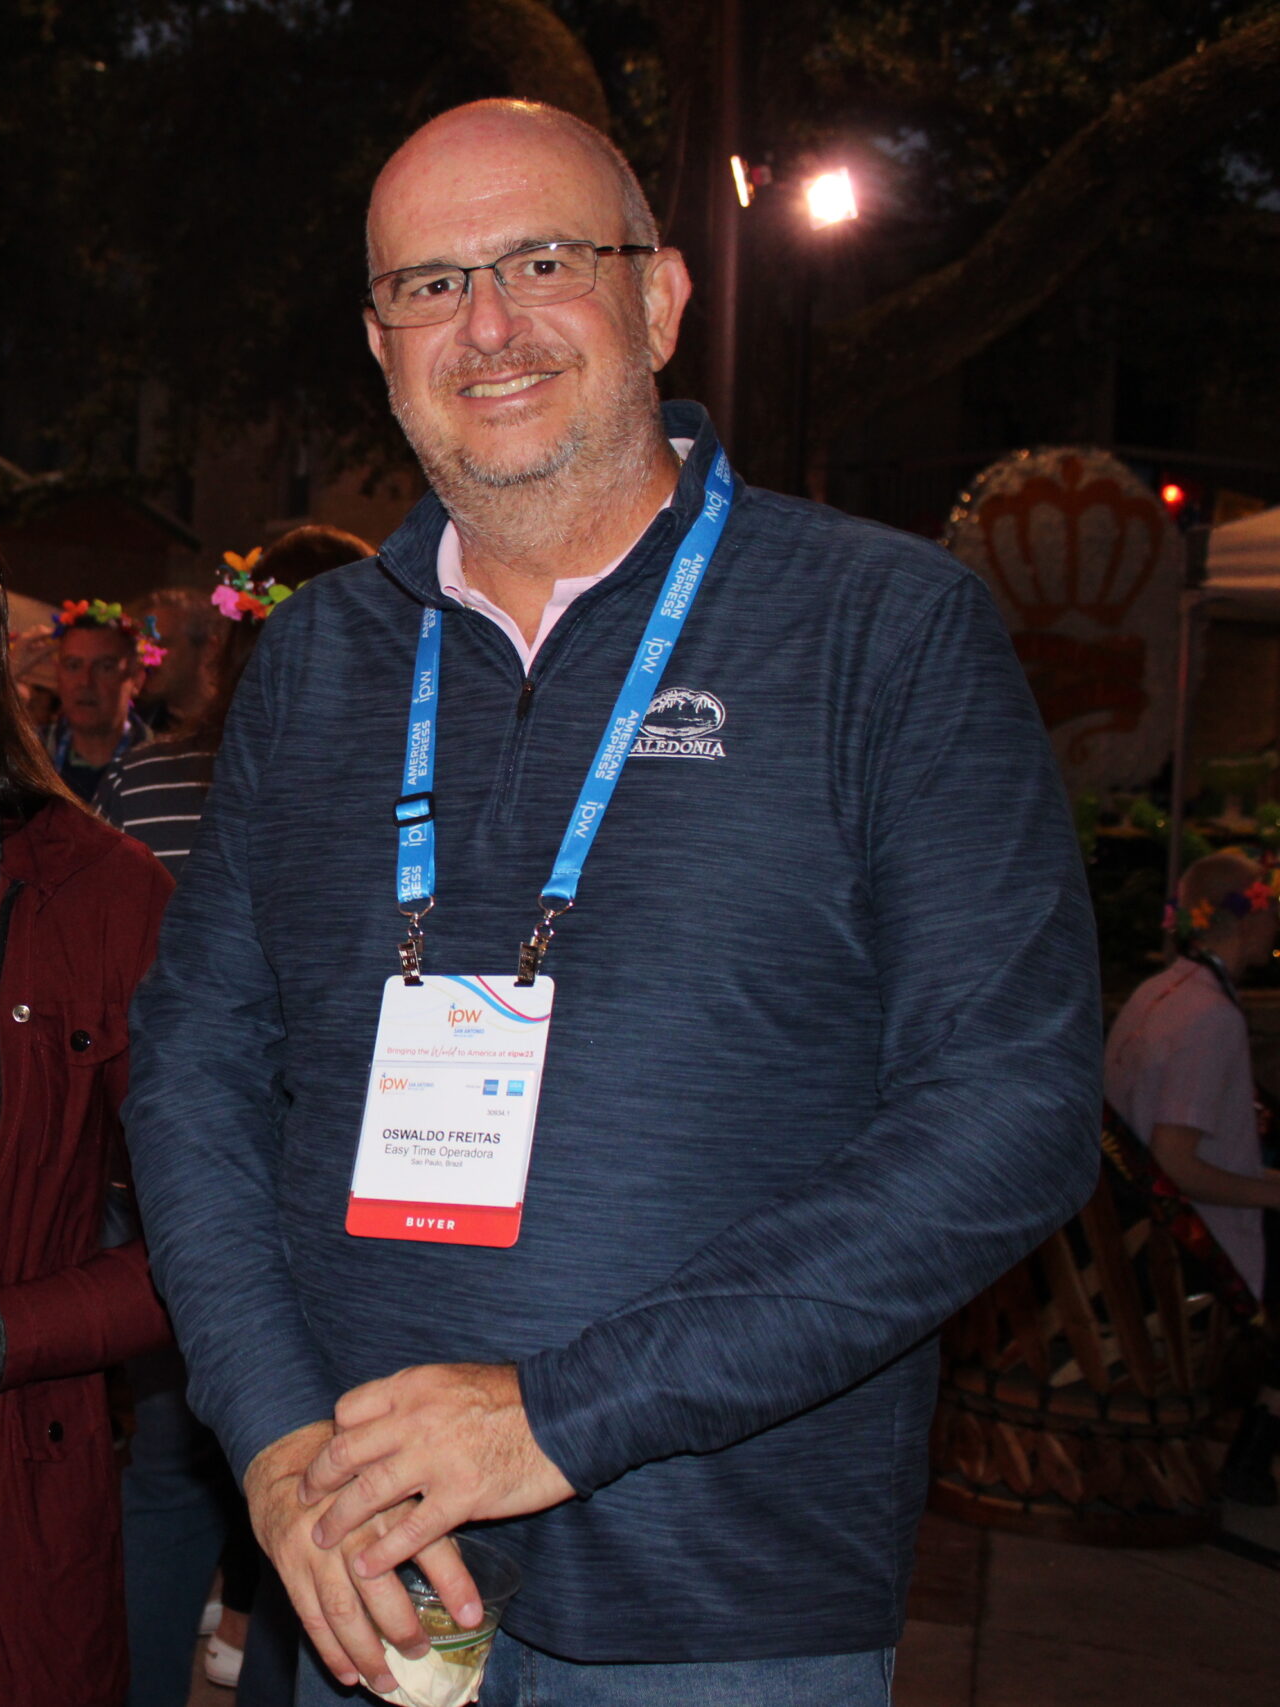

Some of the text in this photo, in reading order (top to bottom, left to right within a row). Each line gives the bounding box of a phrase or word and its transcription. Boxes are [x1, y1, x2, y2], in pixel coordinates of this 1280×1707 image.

[660, 558, 691, 617] EXPRESS
[670, 553, 705, 620] AMERICAN
[641, 637, 673, 674] ipw
[413, 671, 434, 703] ipw
[407, 722, 421, 785] AMERICAN
[418, 720, 431, 776] EXPRESS
[595, 717, 626, 779] EXPRESS
[605, 710, 640, 781] AMERICAN
[630, 740, 726, 757] ALEDONIA
[576, 800, 605, 838] ipw
[411, 865, 422, 899] RESS
[448, 1003, 483, 1027] ipw
[379, 1072, 408, 1094] ipw
[382, 1129, 501, 1144] OSWALDO FREITAS
[385, 1144, 493, 1159] Easy Time Operadora
[406, 1217, 456, 1230] BUYER
